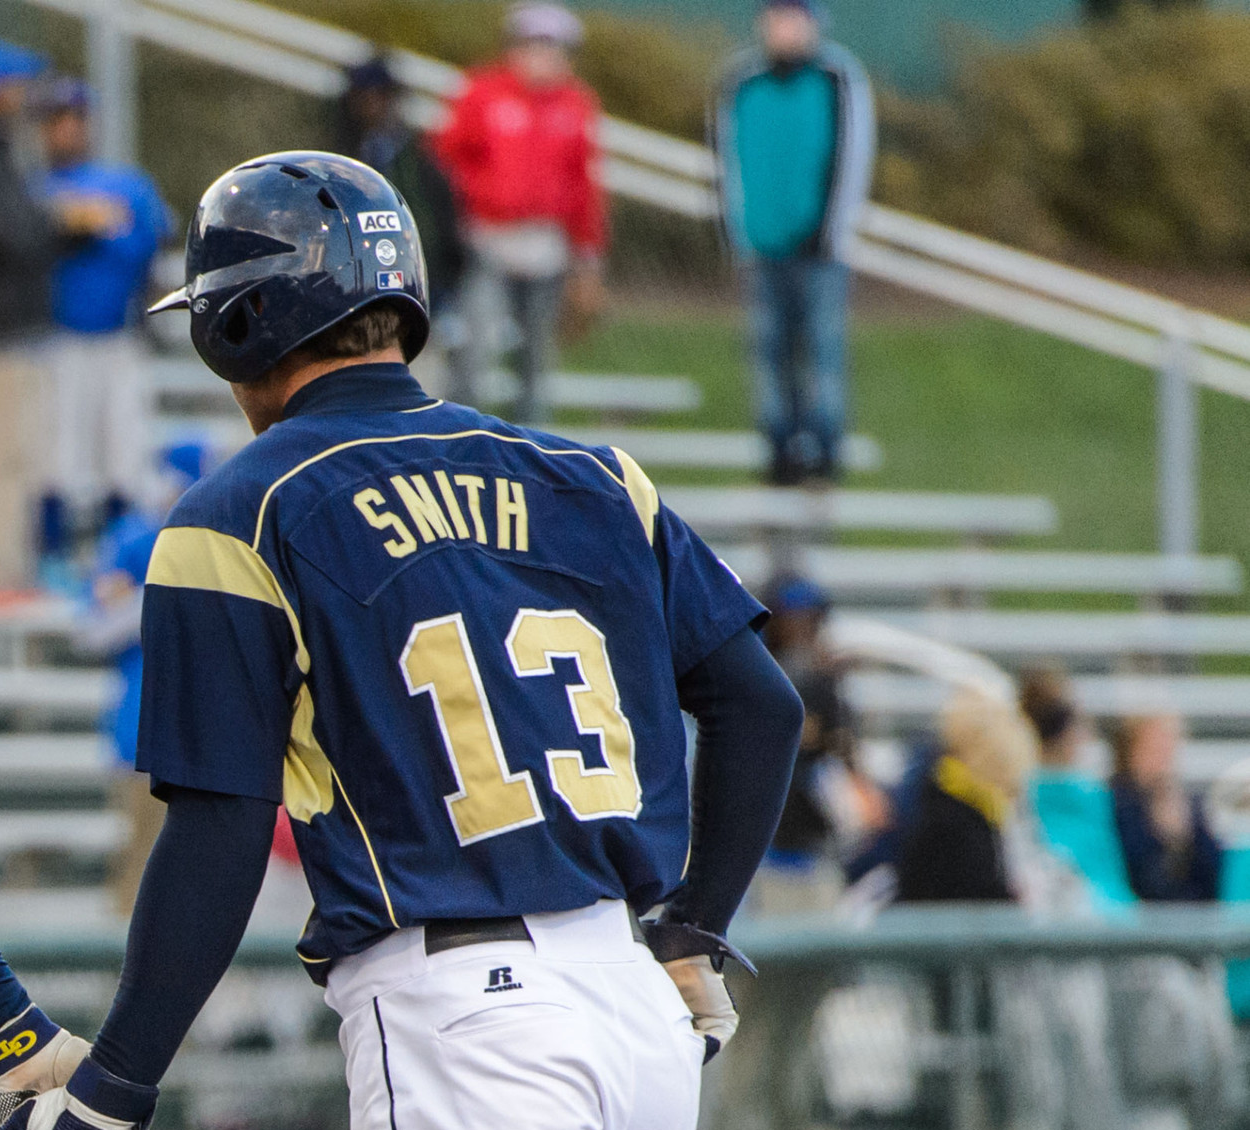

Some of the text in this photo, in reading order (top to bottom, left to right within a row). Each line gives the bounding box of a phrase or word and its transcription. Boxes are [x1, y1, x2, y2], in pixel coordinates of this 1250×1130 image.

[364, 214, 396, 230] ACC
[353, 469, 529, 558] SMITH
[398, 607, 643, 847] 13
